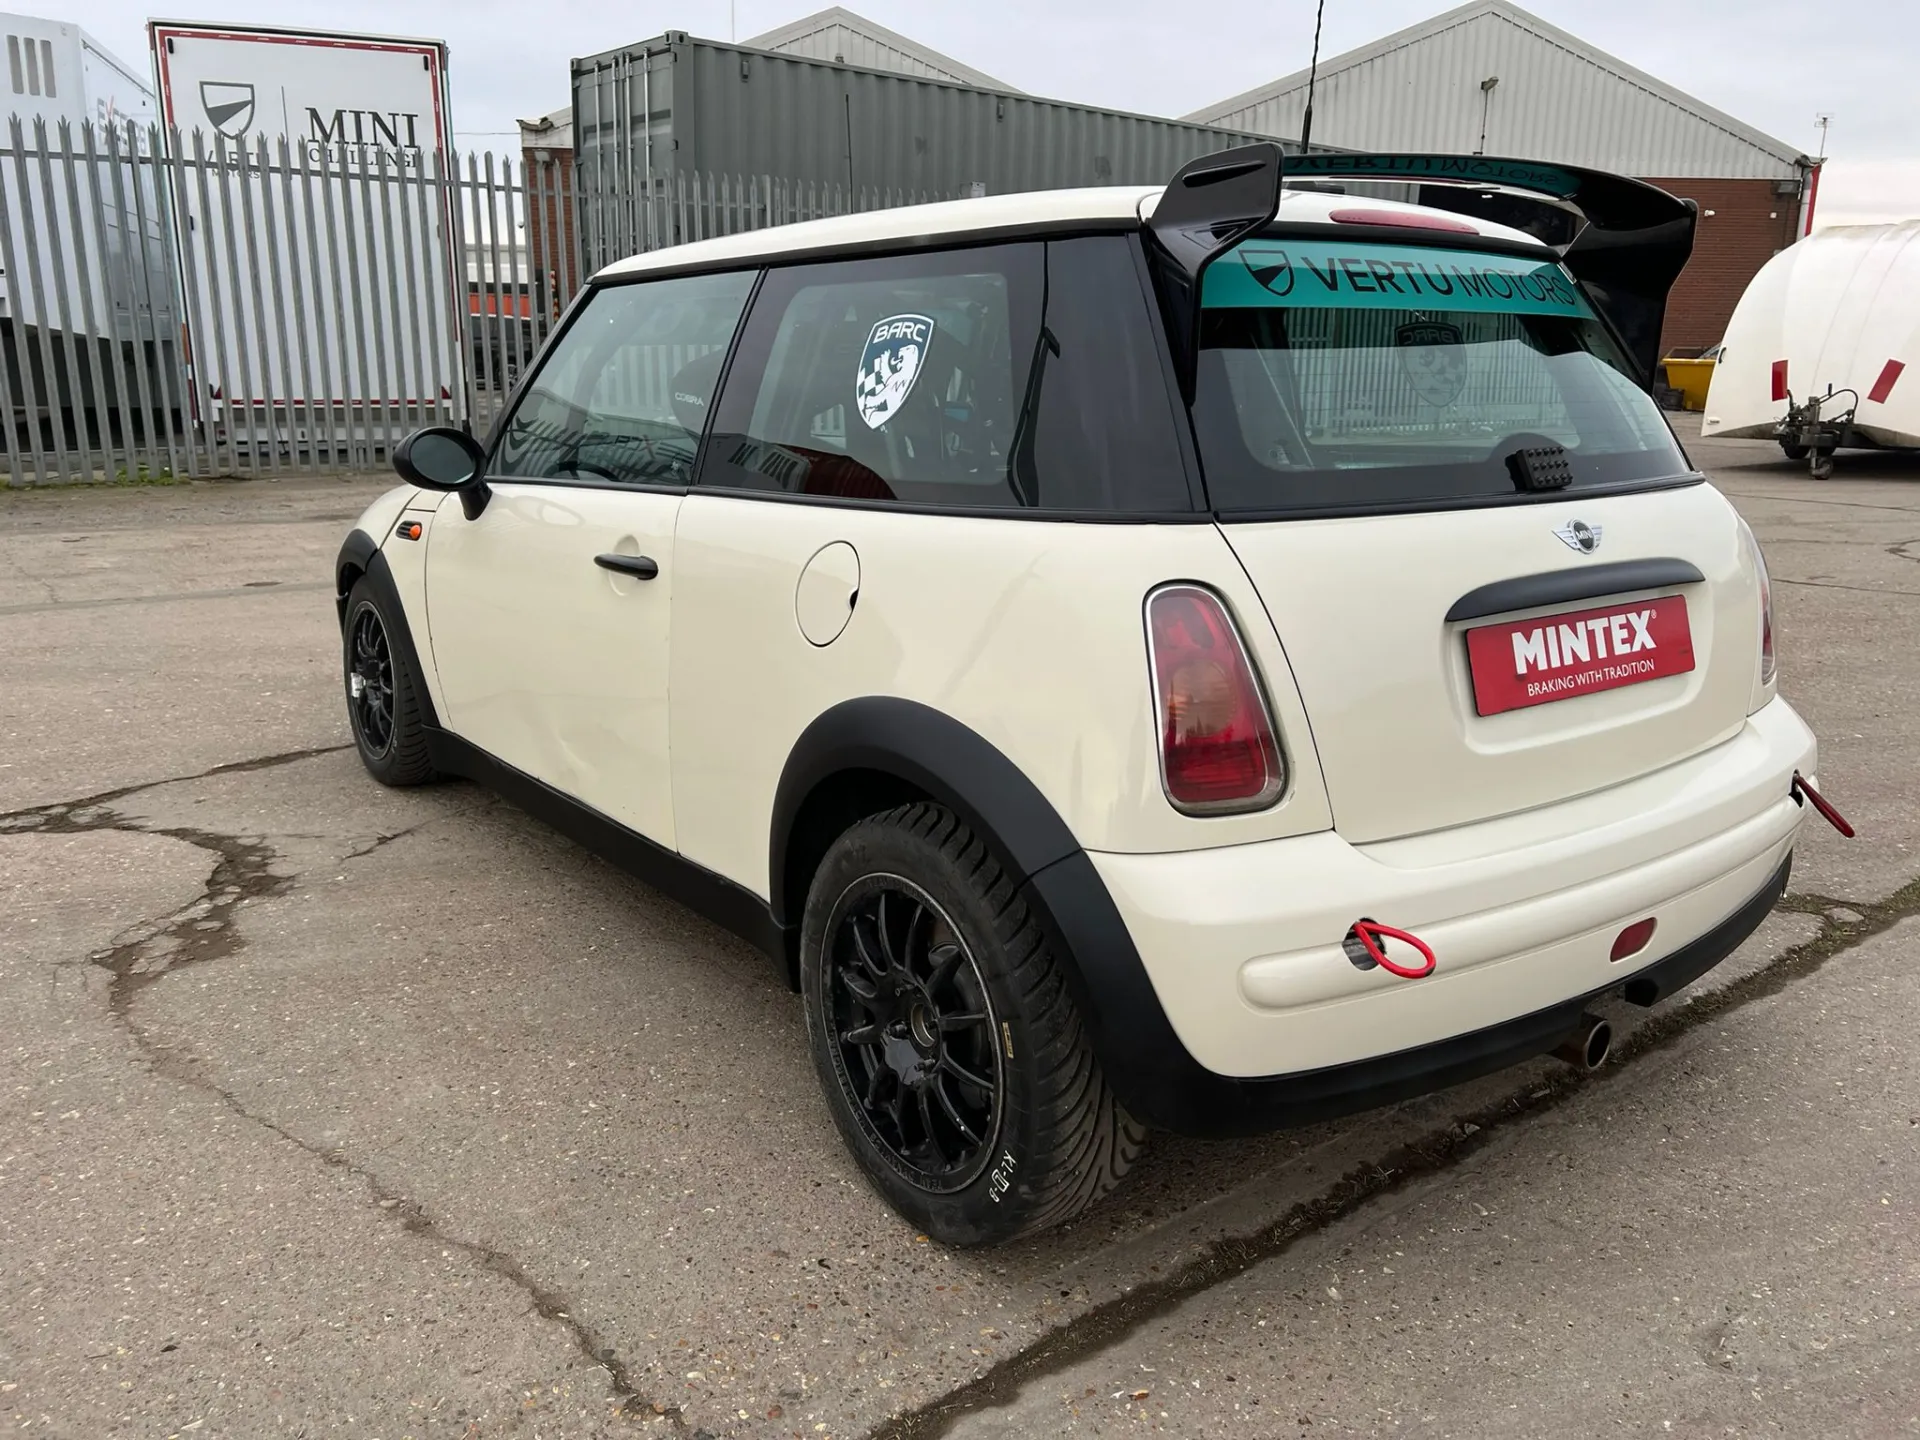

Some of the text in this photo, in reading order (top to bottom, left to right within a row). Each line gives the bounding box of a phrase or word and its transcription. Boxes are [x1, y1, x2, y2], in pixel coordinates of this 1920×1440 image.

[305, 107, 418, 148] MINI
[1301, 256, 1576, 306] VERTU MOTORS
[873, 321, 926, 344] BARC
[1575, 529, 1594, 541] MINI
[1527, 658, 1655, 697] BRAKING WITH TRADITION
